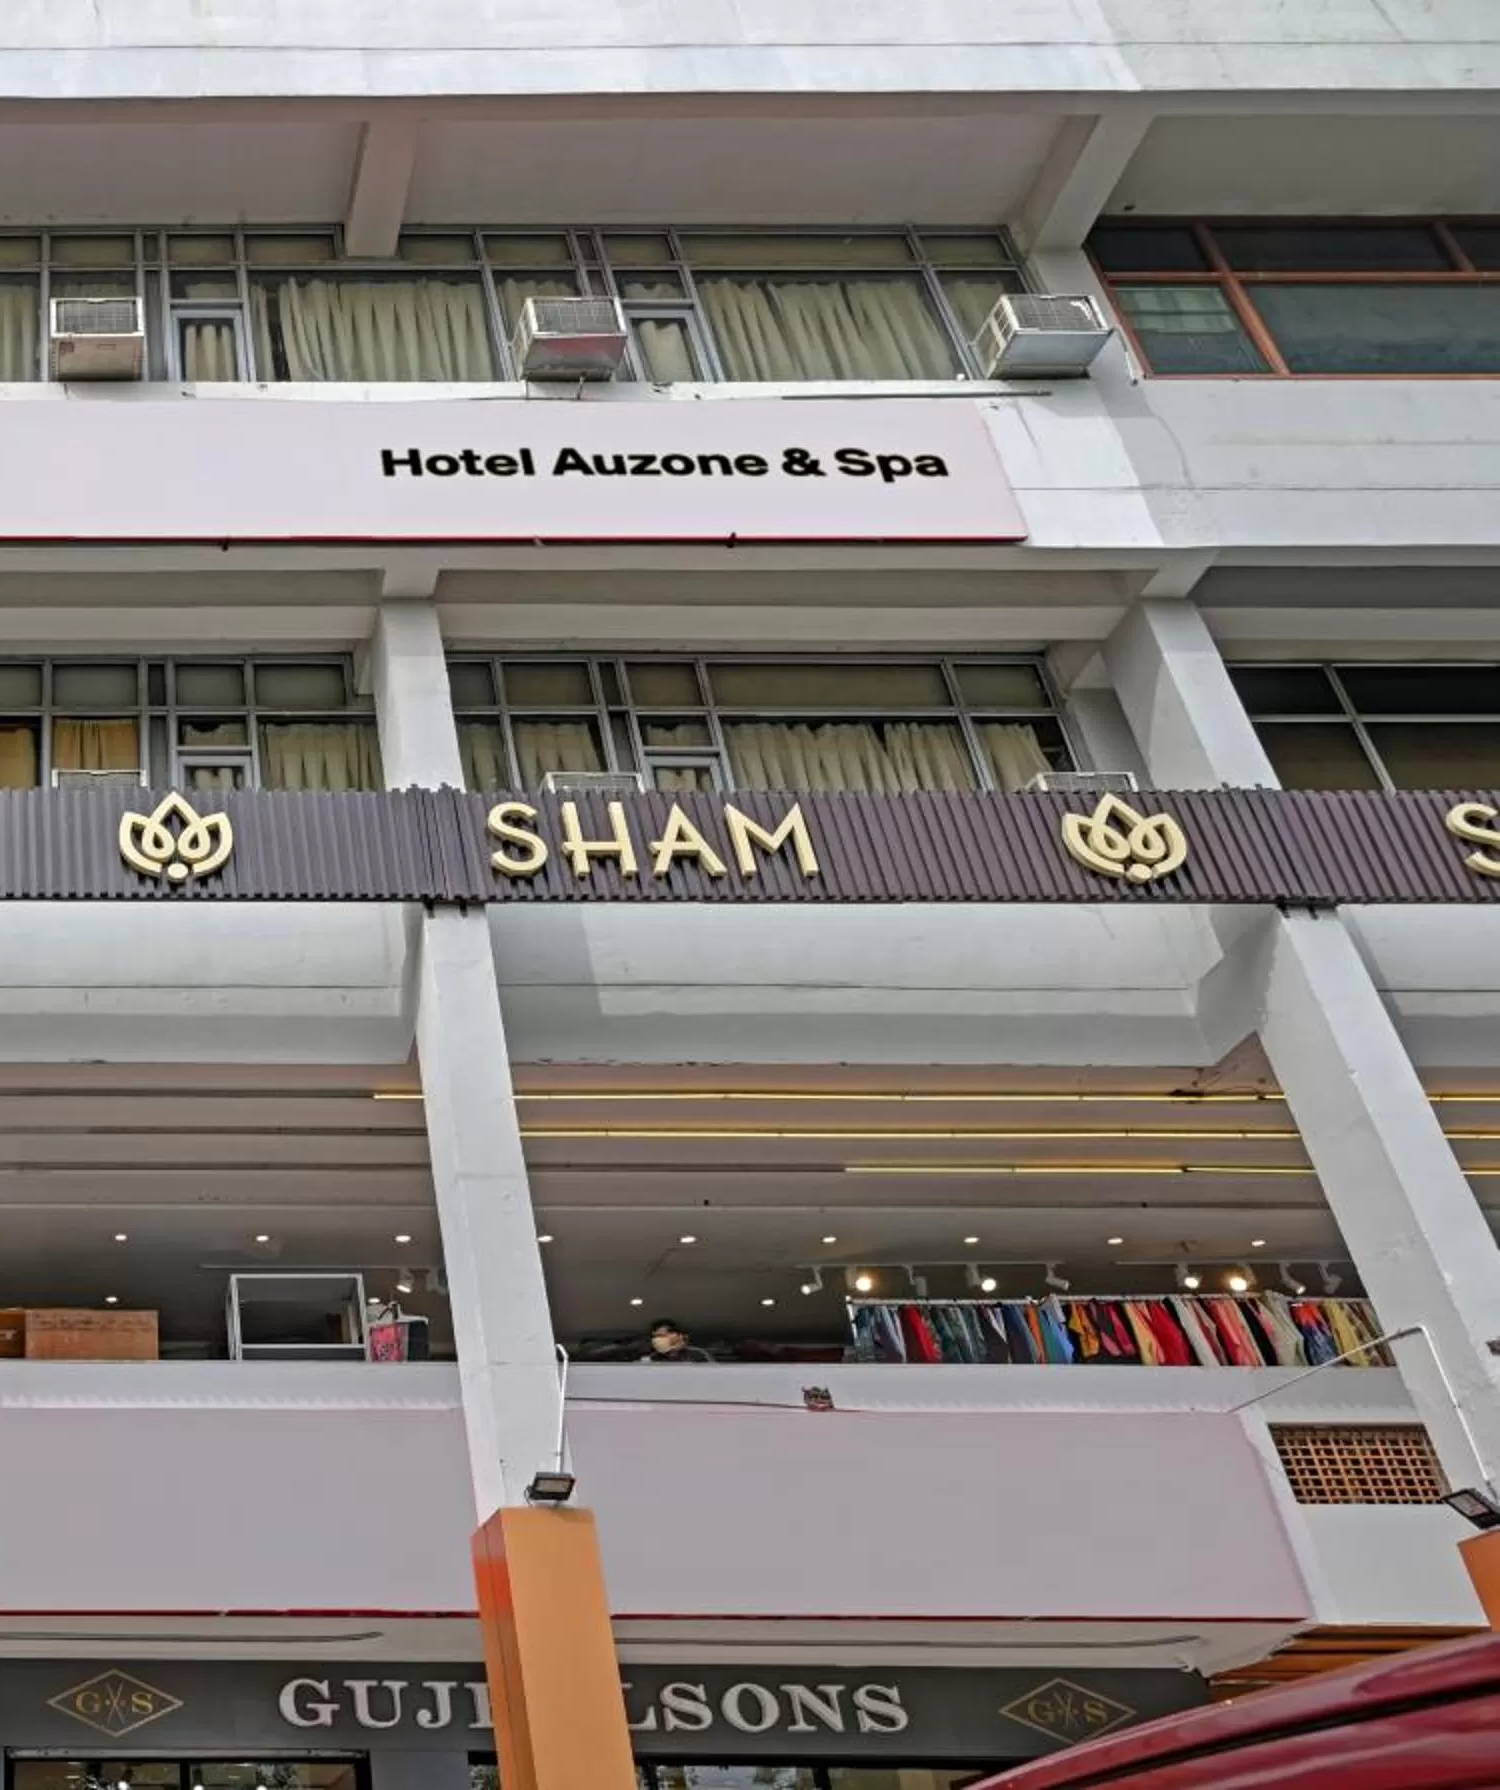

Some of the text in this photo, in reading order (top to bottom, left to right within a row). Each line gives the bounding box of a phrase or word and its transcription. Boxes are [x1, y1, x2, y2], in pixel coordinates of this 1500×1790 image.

[381, 447, 950, 484] Hotel Auzone & Spa
[488, 801, 820, 880] SHAM
